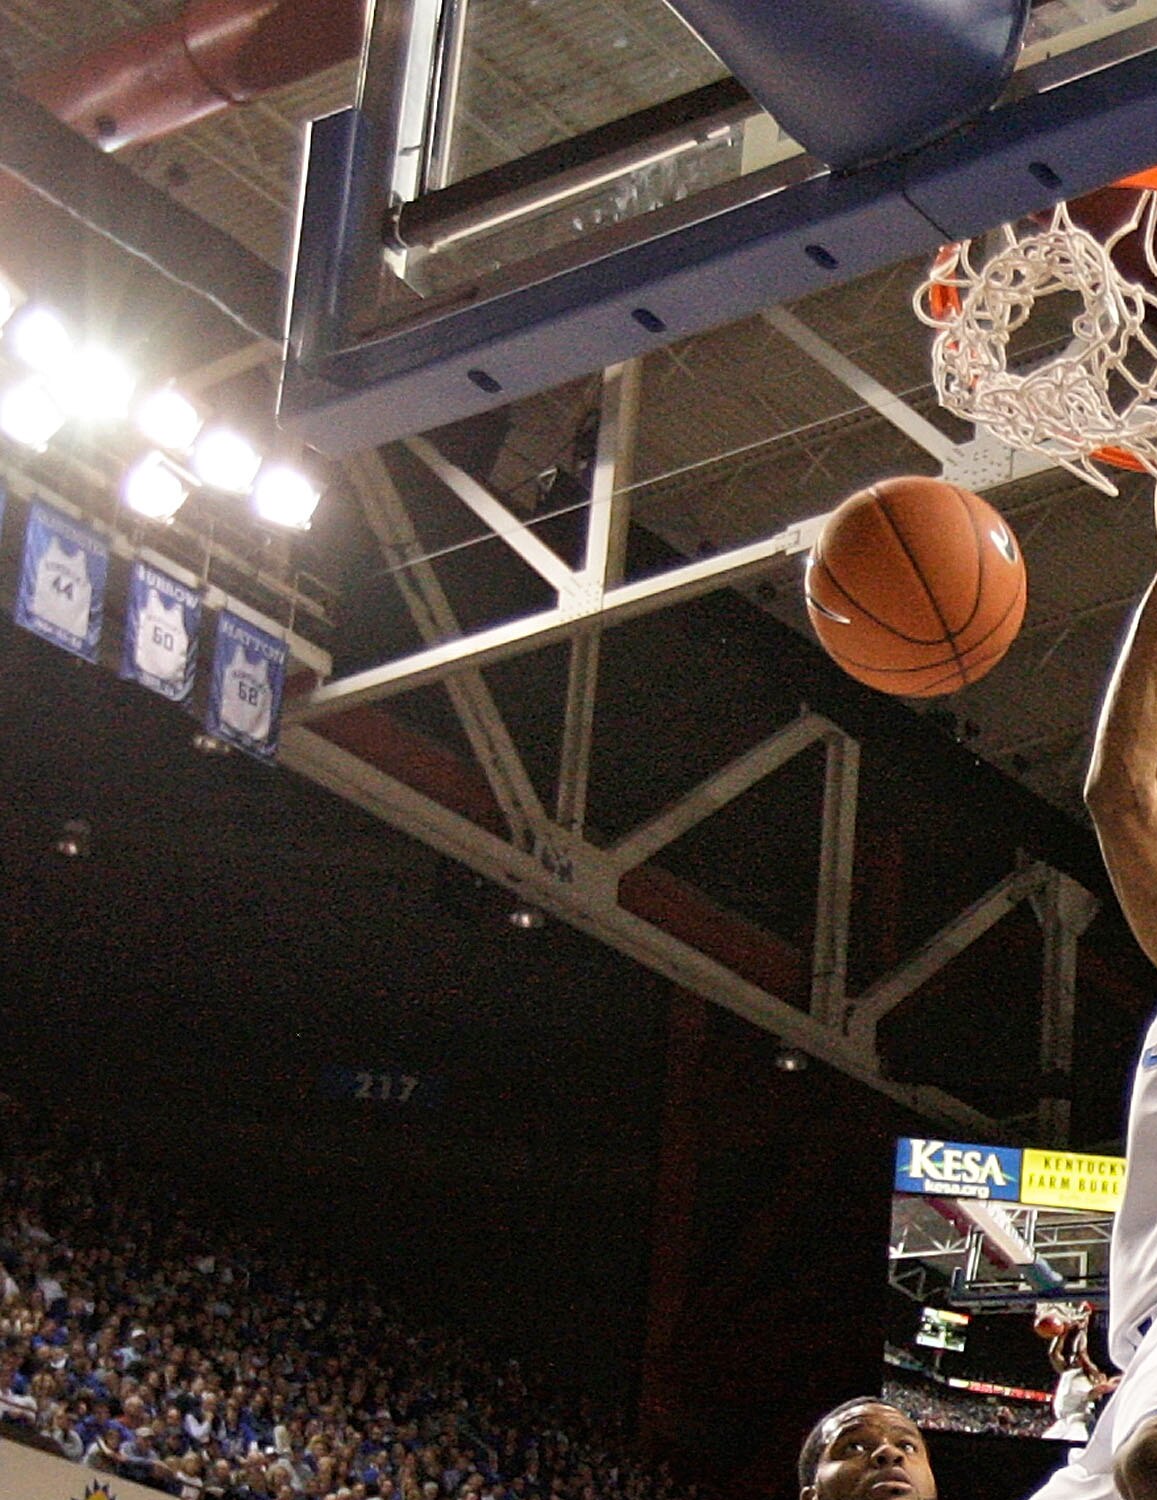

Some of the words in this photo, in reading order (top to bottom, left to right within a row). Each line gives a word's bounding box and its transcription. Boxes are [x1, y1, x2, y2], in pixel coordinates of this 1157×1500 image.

[909, 1138, 1007, 1187] KESA
[1028, 1171, 1071, 1191] FARM
[1078, 1177, 1119, 1197] BURE
